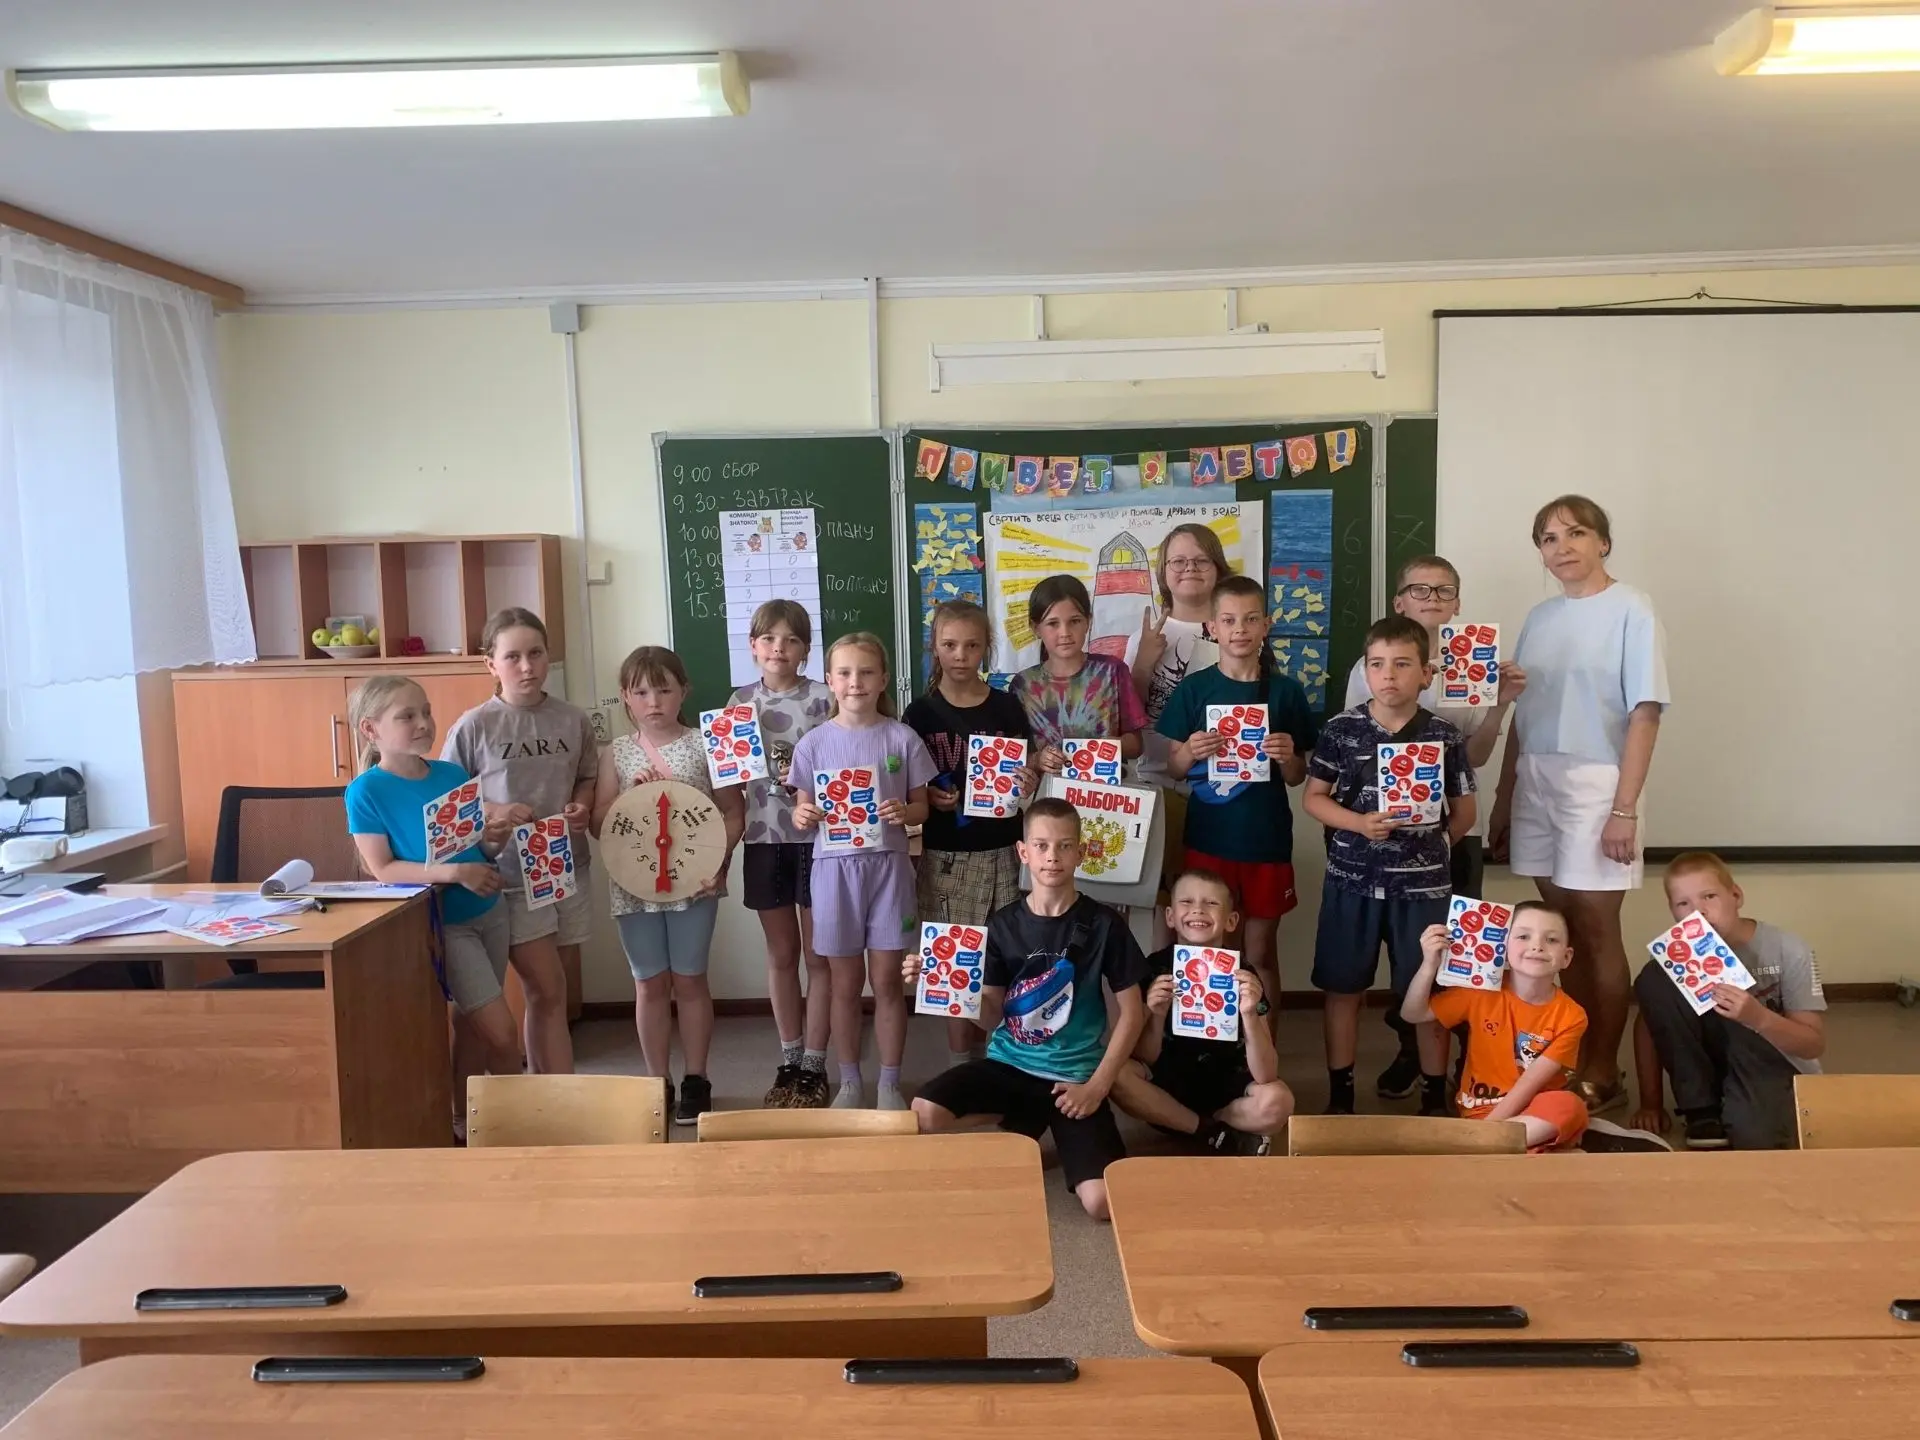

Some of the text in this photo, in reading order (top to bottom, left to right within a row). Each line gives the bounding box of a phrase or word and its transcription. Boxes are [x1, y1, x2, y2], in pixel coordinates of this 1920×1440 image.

[500, 738, 570, 760] ZARA
[1065, 787, 1141, 815] ВЫБОРЫ
[1133, 823, 1141, 839] 1
